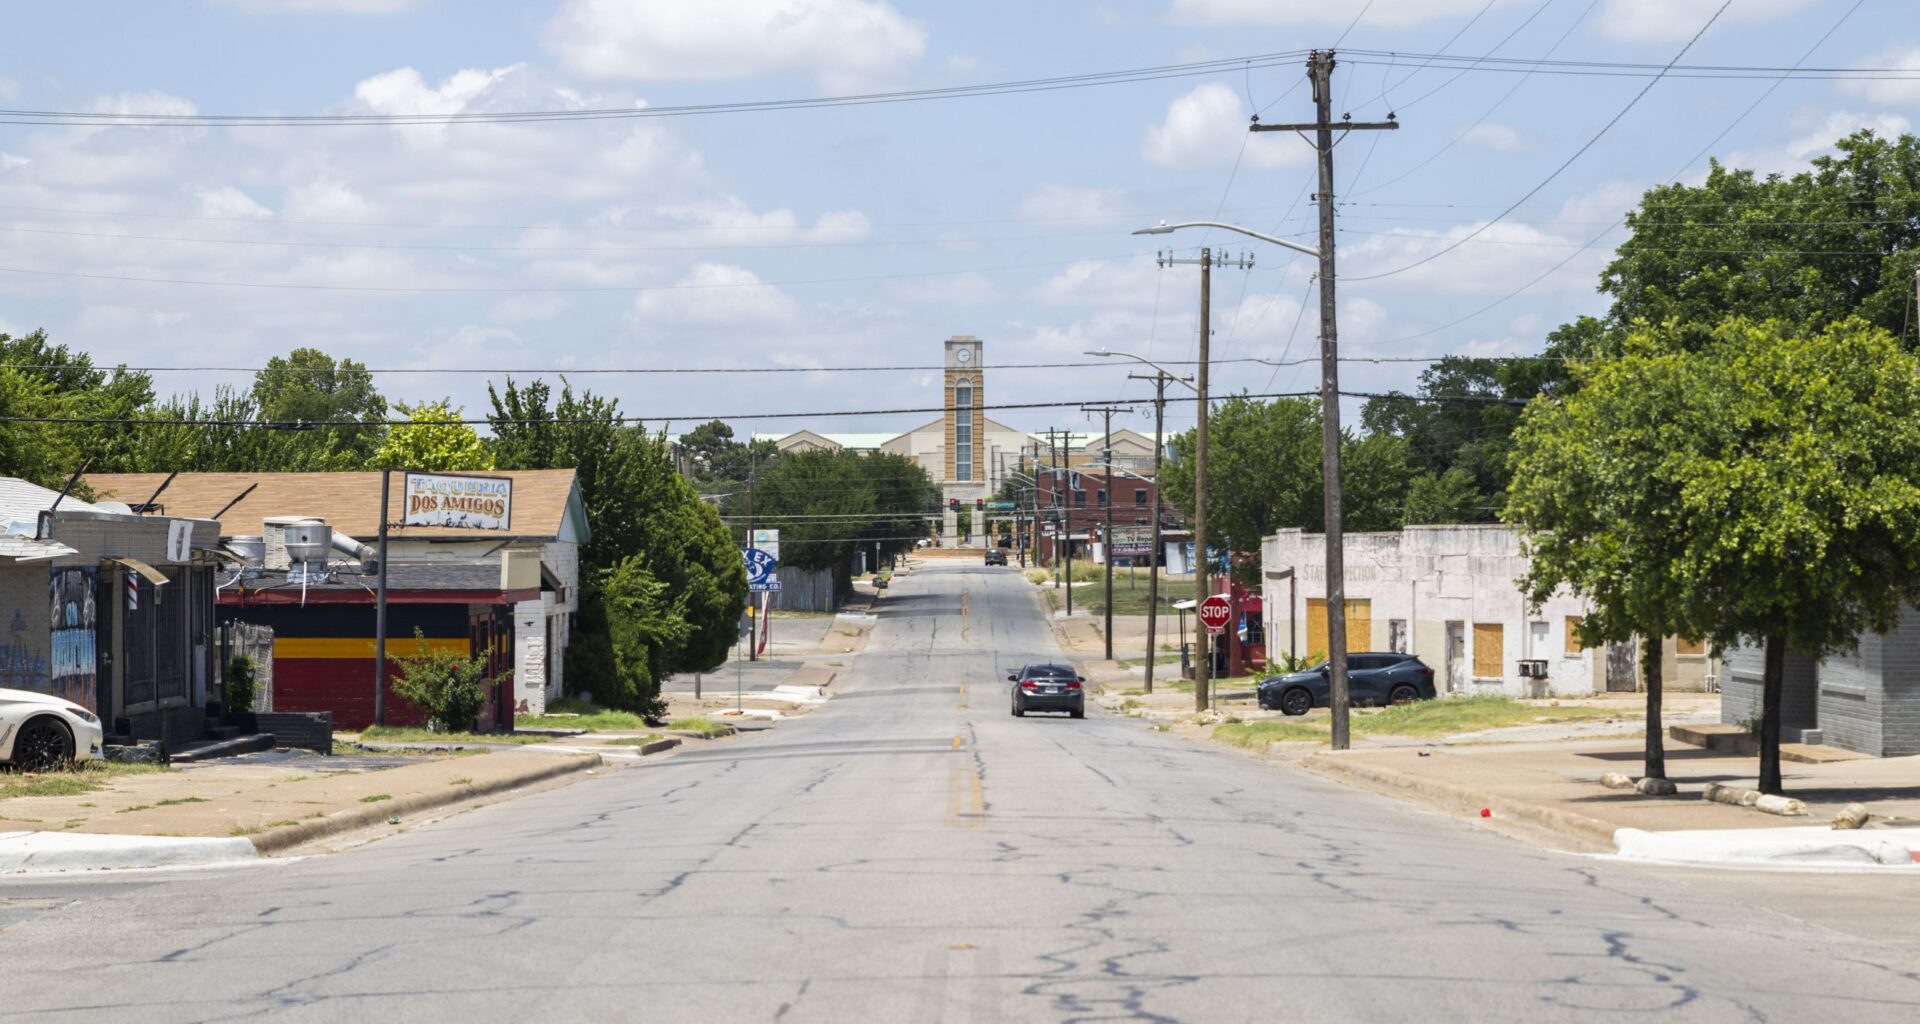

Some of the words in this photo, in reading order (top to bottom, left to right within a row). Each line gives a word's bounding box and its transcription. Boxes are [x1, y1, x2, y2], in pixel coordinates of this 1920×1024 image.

[411, 479, 507, 497] TAQUERIA
[410, 495, 438, 515] DOS
[442, 496, 505, 519] AMIGOS
[1303, 564, 1327, 581] STAT
[1343, 565, 1376, 582] PECTION
[1202, 606, 1229, 618] STOP
